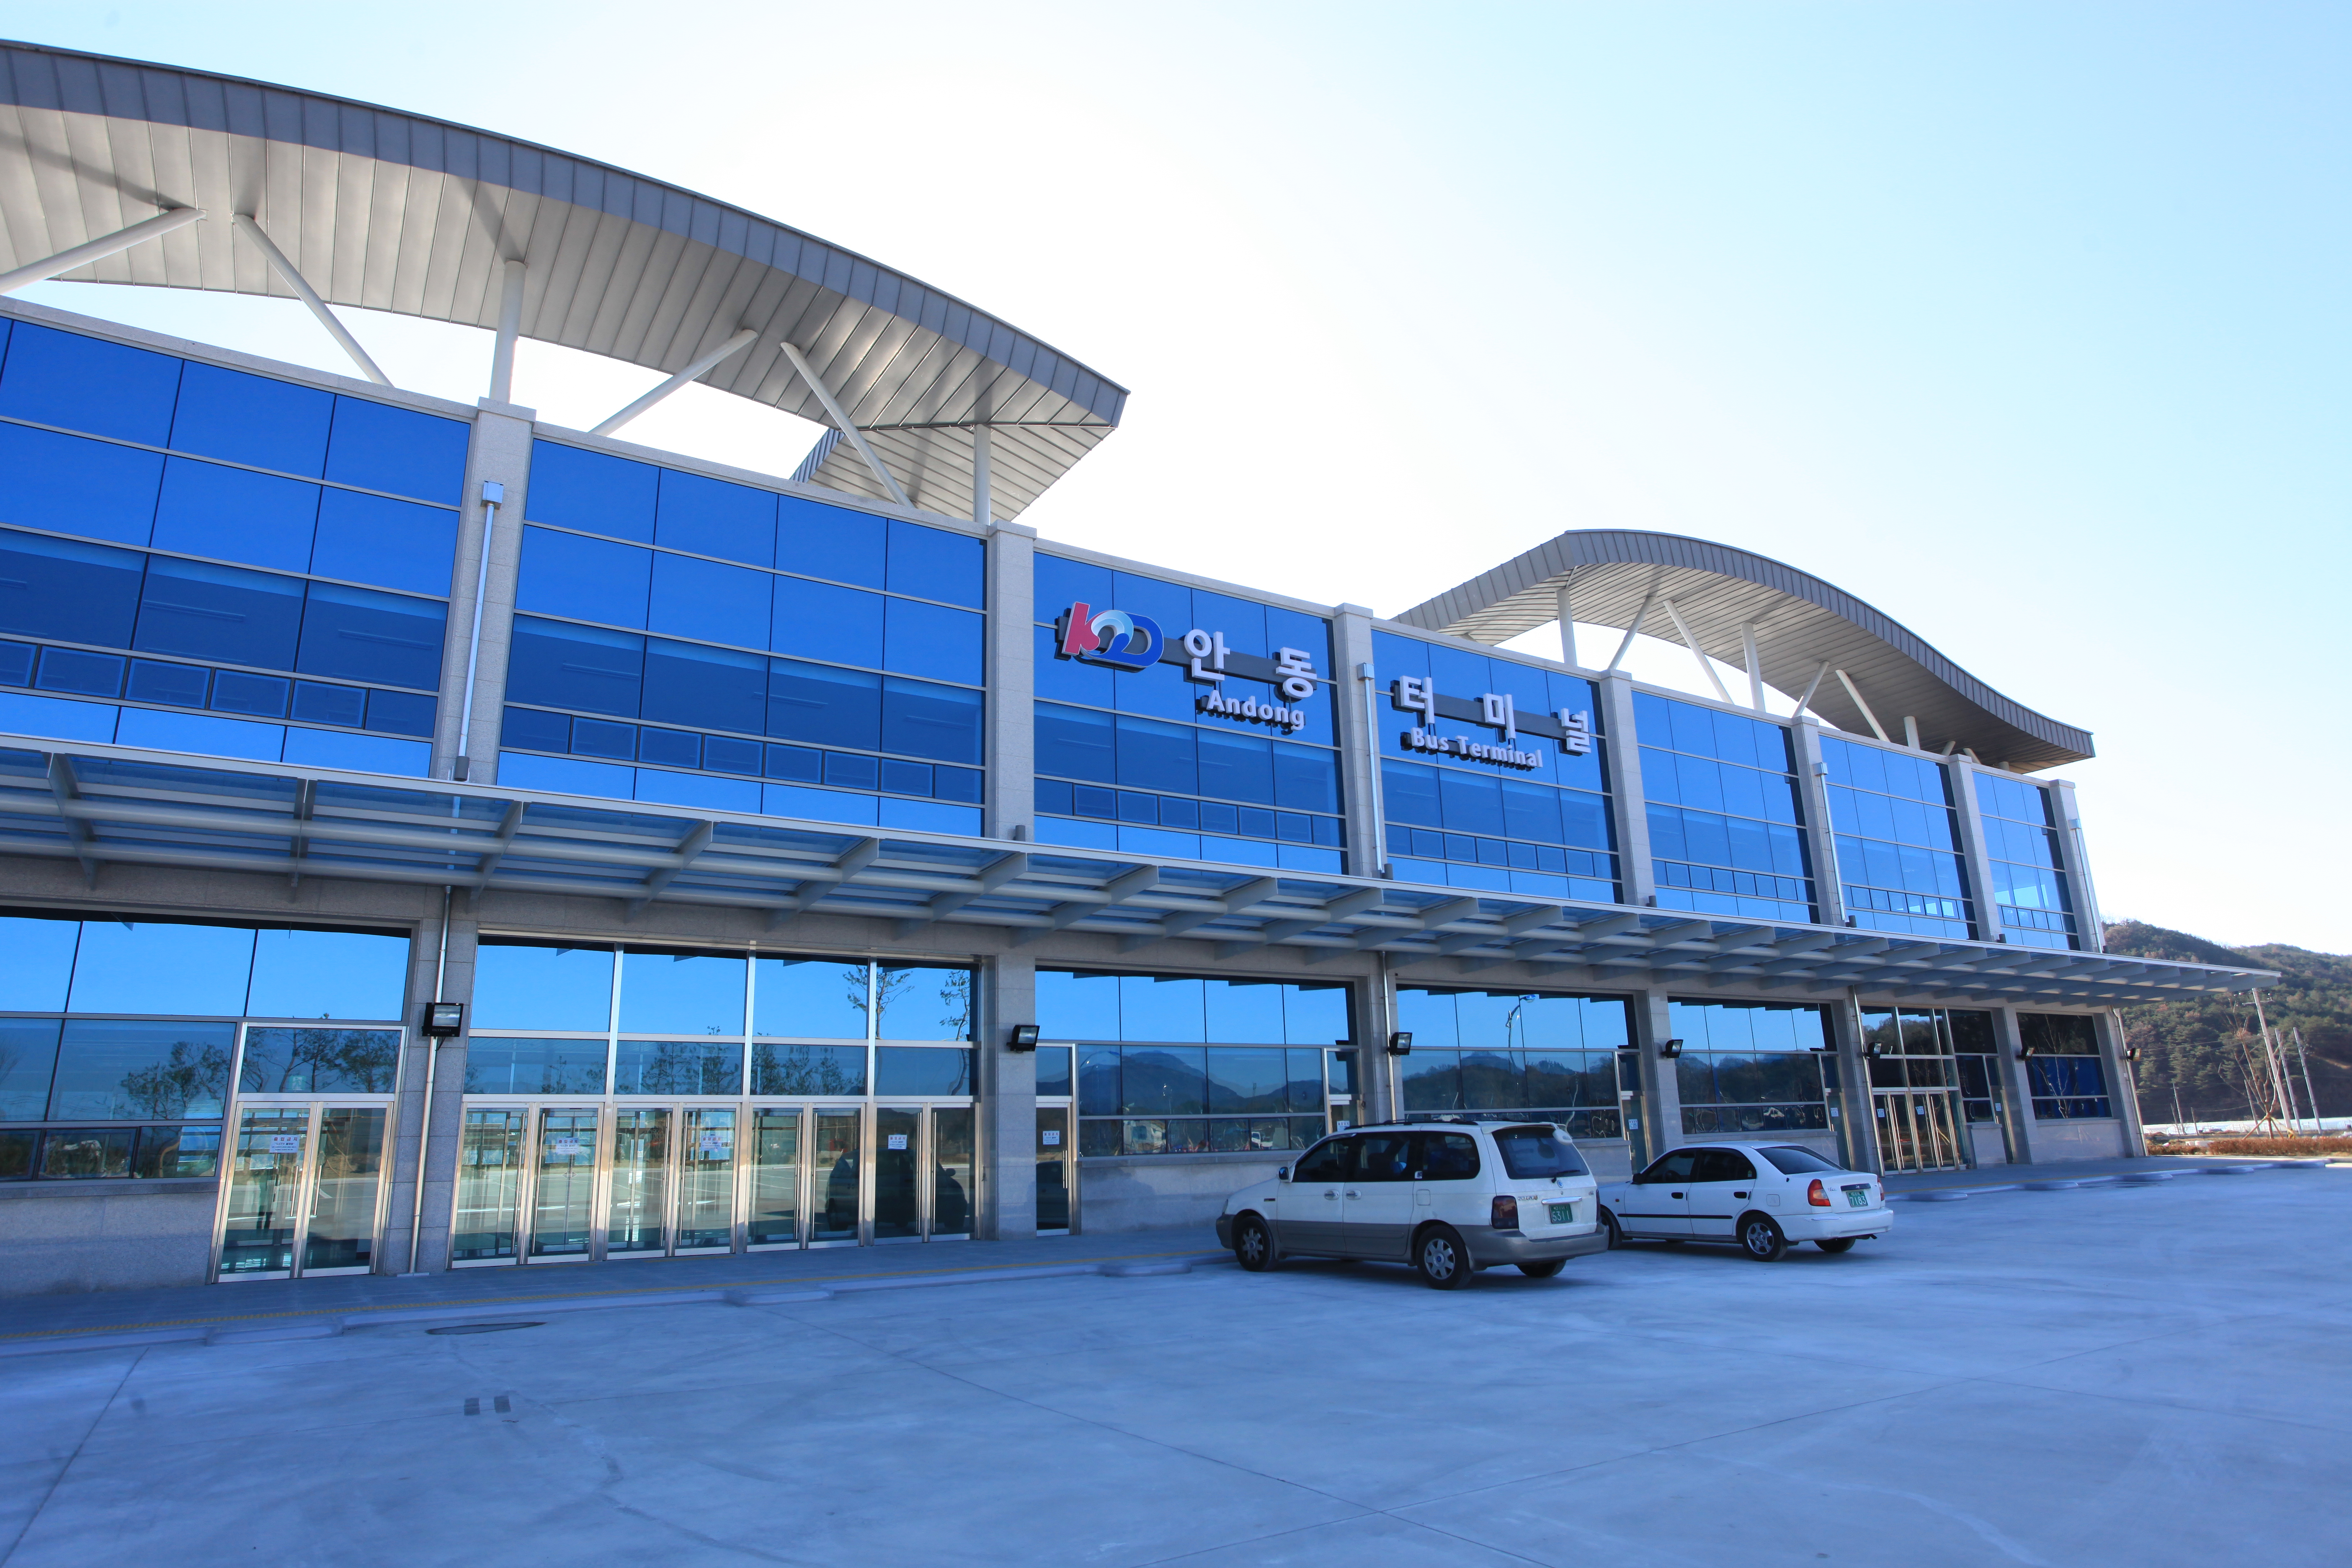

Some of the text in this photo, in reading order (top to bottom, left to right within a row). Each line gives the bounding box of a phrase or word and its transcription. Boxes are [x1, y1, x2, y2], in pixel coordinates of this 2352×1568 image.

[1184, 629, 1591, 753] 안동 터미널
[1206, 689, 1543, 768] Andong Bus Terminal
[1552, 1210, 1570, 1221] 5311
[1849, 1196, 1866, 1205] 7183
